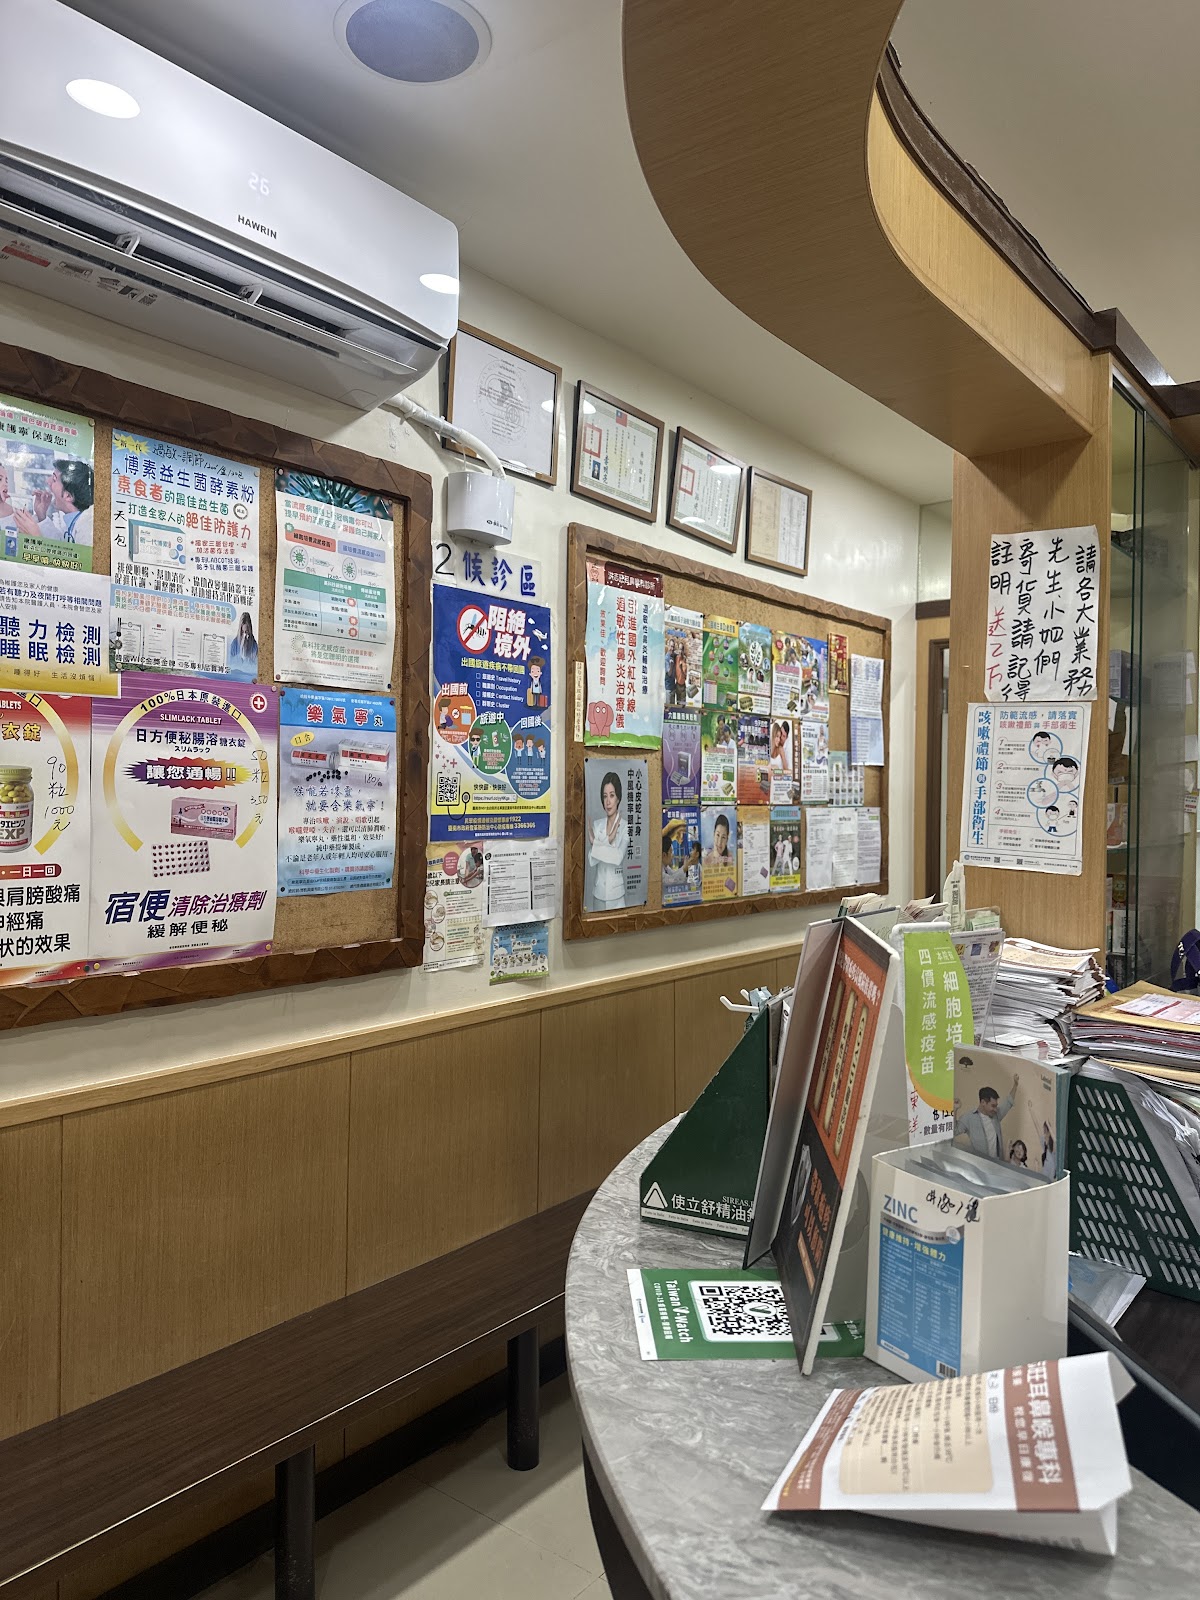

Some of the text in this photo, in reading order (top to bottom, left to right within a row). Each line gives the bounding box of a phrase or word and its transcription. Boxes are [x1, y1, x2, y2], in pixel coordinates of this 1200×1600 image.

[249, 172, 270, 197] 26
[237, 214, 277, 240] HAWRIN
[124, 454, 255, 504] 博素益生菌酵素粉
[117, 475, 229, 516] 素食者的最佳益生菌
[114, 499, 127, 548] 一天一包
[128, 502, 252, 540] 打造全家人的絕佳防護力
[435, 543, 455, 576] 2
[463, 550, 536, 597] 候診區
[0, 615, 101, 646] 聽力檢測
[487, 604, 527, 635] 阻絕
[1001, 538, 1038, 702] 寄貨請記得
[1063, 544, 1096, 697] 請各大業務
[0, 639, 101, 667] 睡眠檢測
[493, 632, 532, 661] 境外
[627, 598, 638, 713] 引進國外紅外線
[615, 597, 626, 729] 過敏性鼻炎治療儀
[140, 689, 242, 720] 100%日本原裝進口
[441, 683, 469, 696] 出國前
[2, 723, 42, 741] 衣錠
[160, 713, 222, 725] SLIMLACK TABLET
[174, 746, 211, 754] スリムラック
[47, 756, 67, 780] 90
[971, 711, 992, 845] 咳嗽禮節與手部衛生
[635, 768, 643, 837] 小心皮蛇上身
[105, 889, 267, 924] 宿便清除治療劑
[147, 918, 229, 938] 緩解便秘
[918, 948, 936, 1075] 四價流感疫苗
[883, 1194, 918, 1223] ZINC
[665, 1280, 681, 1306] Taiwan
